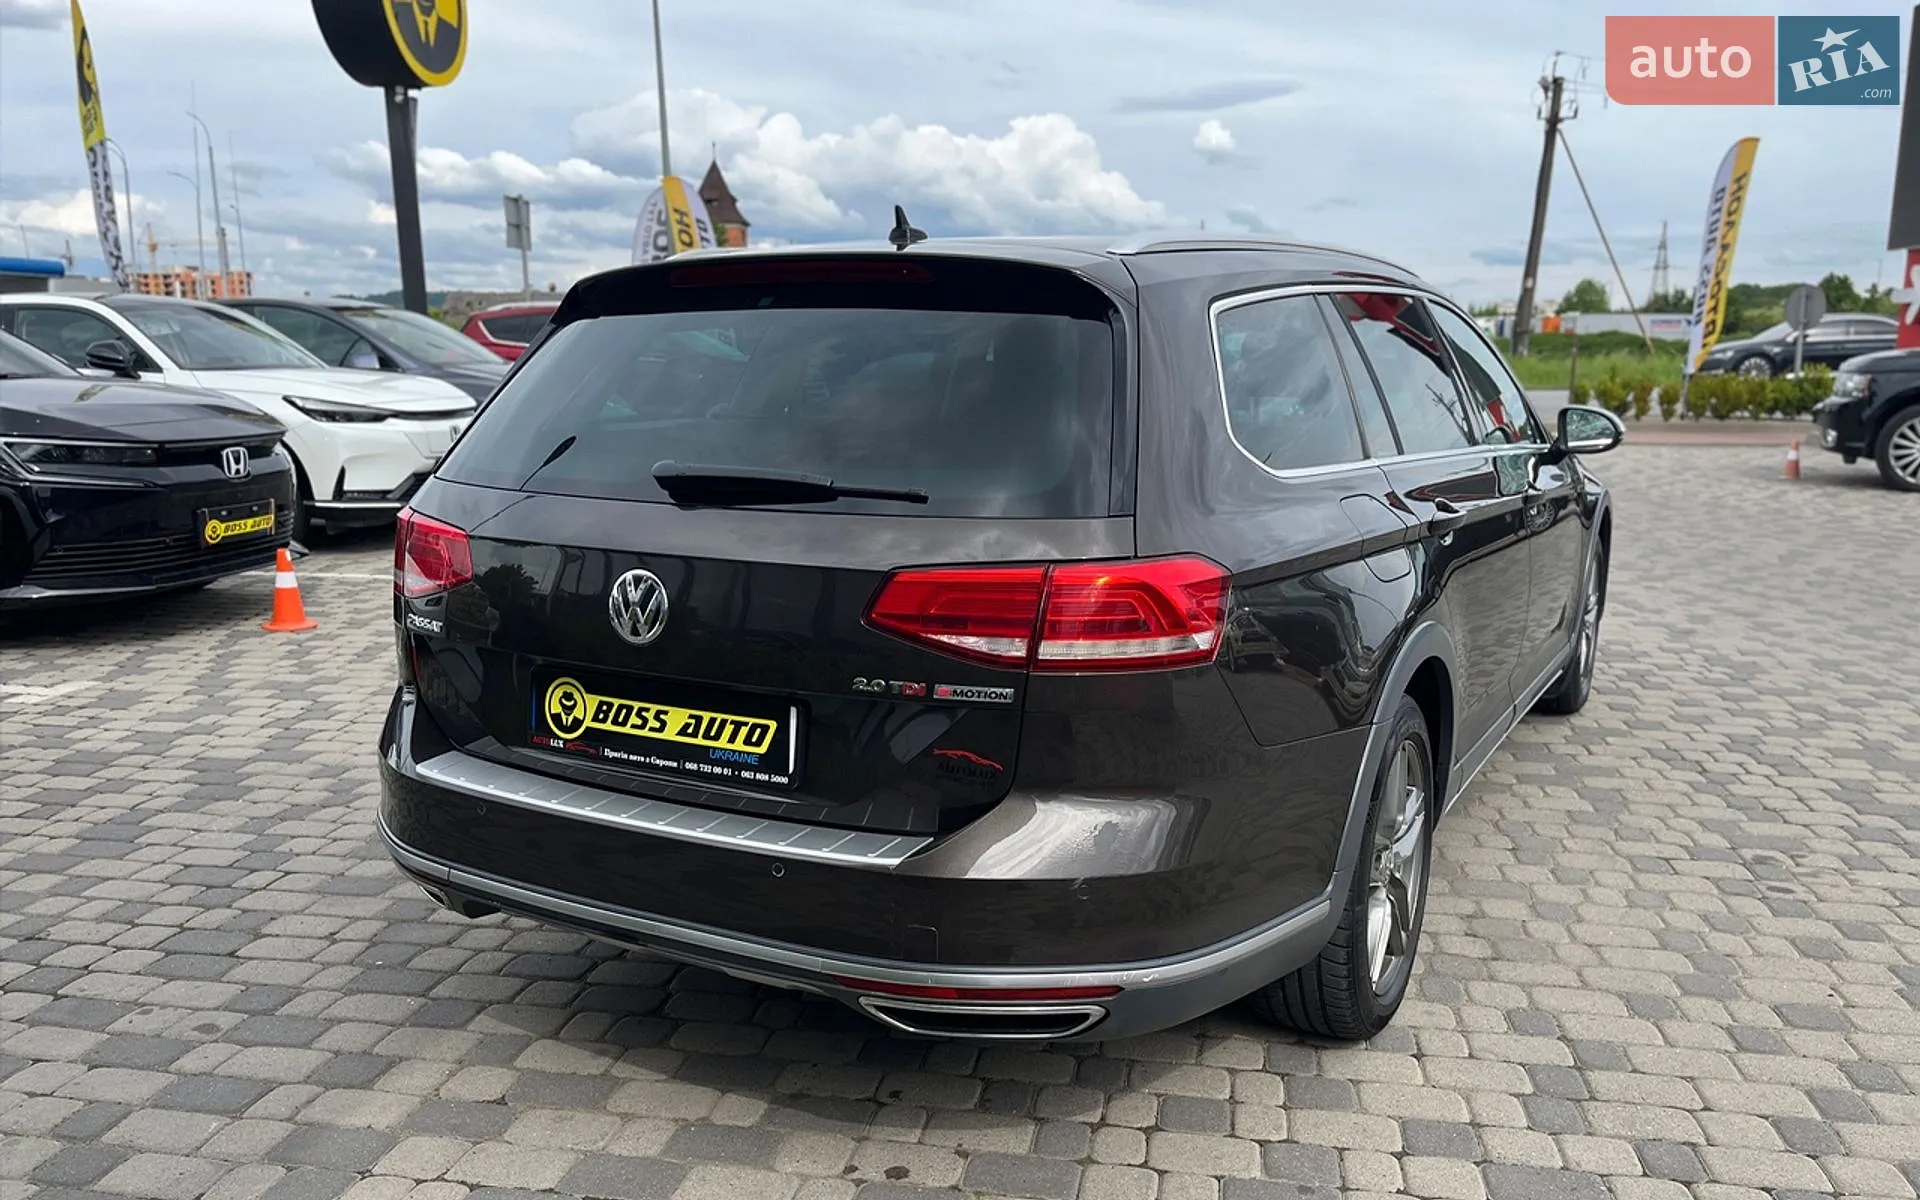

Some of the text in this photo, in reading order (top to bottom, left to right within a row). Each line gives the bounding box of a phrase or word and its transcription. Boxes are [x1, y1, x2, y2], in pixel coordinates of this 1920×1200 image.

[223, 521, 248, 534] BOSS
[407, 613, 444, 633] PASSAT
[852, 677, 886, 693] 2.0
[590, 699, 771, 748] BOSS AUTO
[709, 748, 760, 765] UKRAINE
[770, 774, 789, 784] 5000
